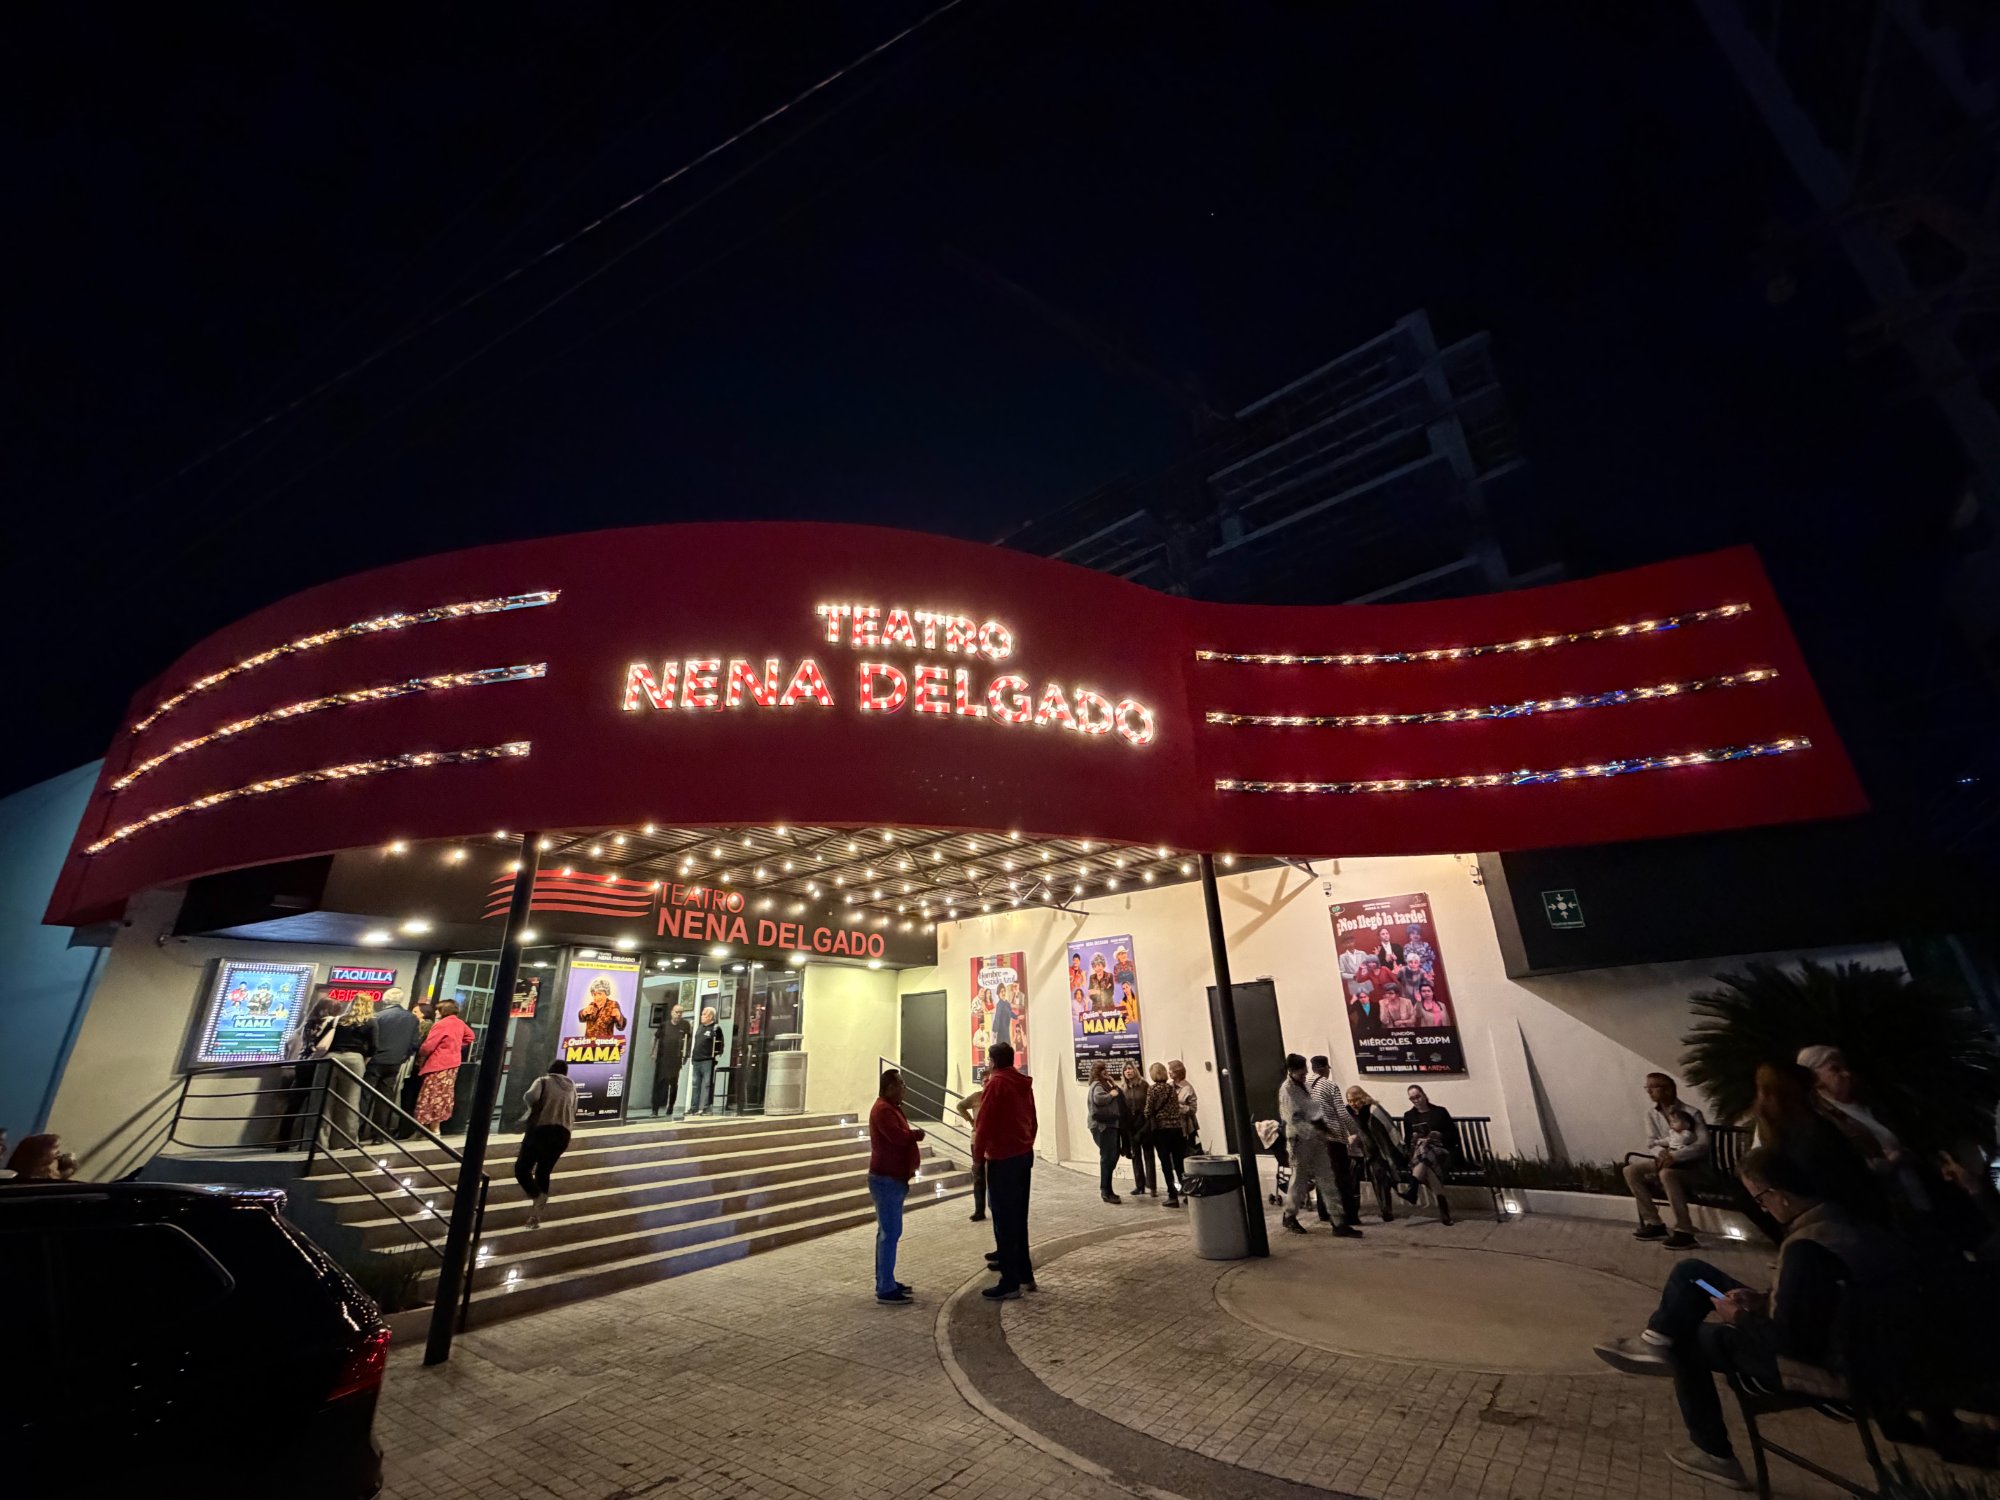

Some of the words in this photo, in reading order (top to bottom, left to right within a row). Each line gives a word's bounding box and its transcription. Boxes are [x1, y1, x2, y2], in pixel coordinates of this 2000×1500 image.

[817, 604, 1013, 659] TEATRO
[623, 659, 834, 711] NENA
[859, 662, 1155, 745] DELGADO
[660, 882, 745, 914] TEATRO
[657, 907, 749, 945] NENA
[757, 919, 884, 958] DELGADO
[1337, 917, 1358, 936] ¡Nos
[1357, 912, 1383, 930] llegó
[1382, 911, 1394, 926] la
[1393, 909, 1427, 925] tarde!
[333, 970, 393, 981] TAQUILLA
[1359, 1037, 1413, 1046] MIÉRCOLES.
[1416, 1036, 1451, 1045] 8:30PM
